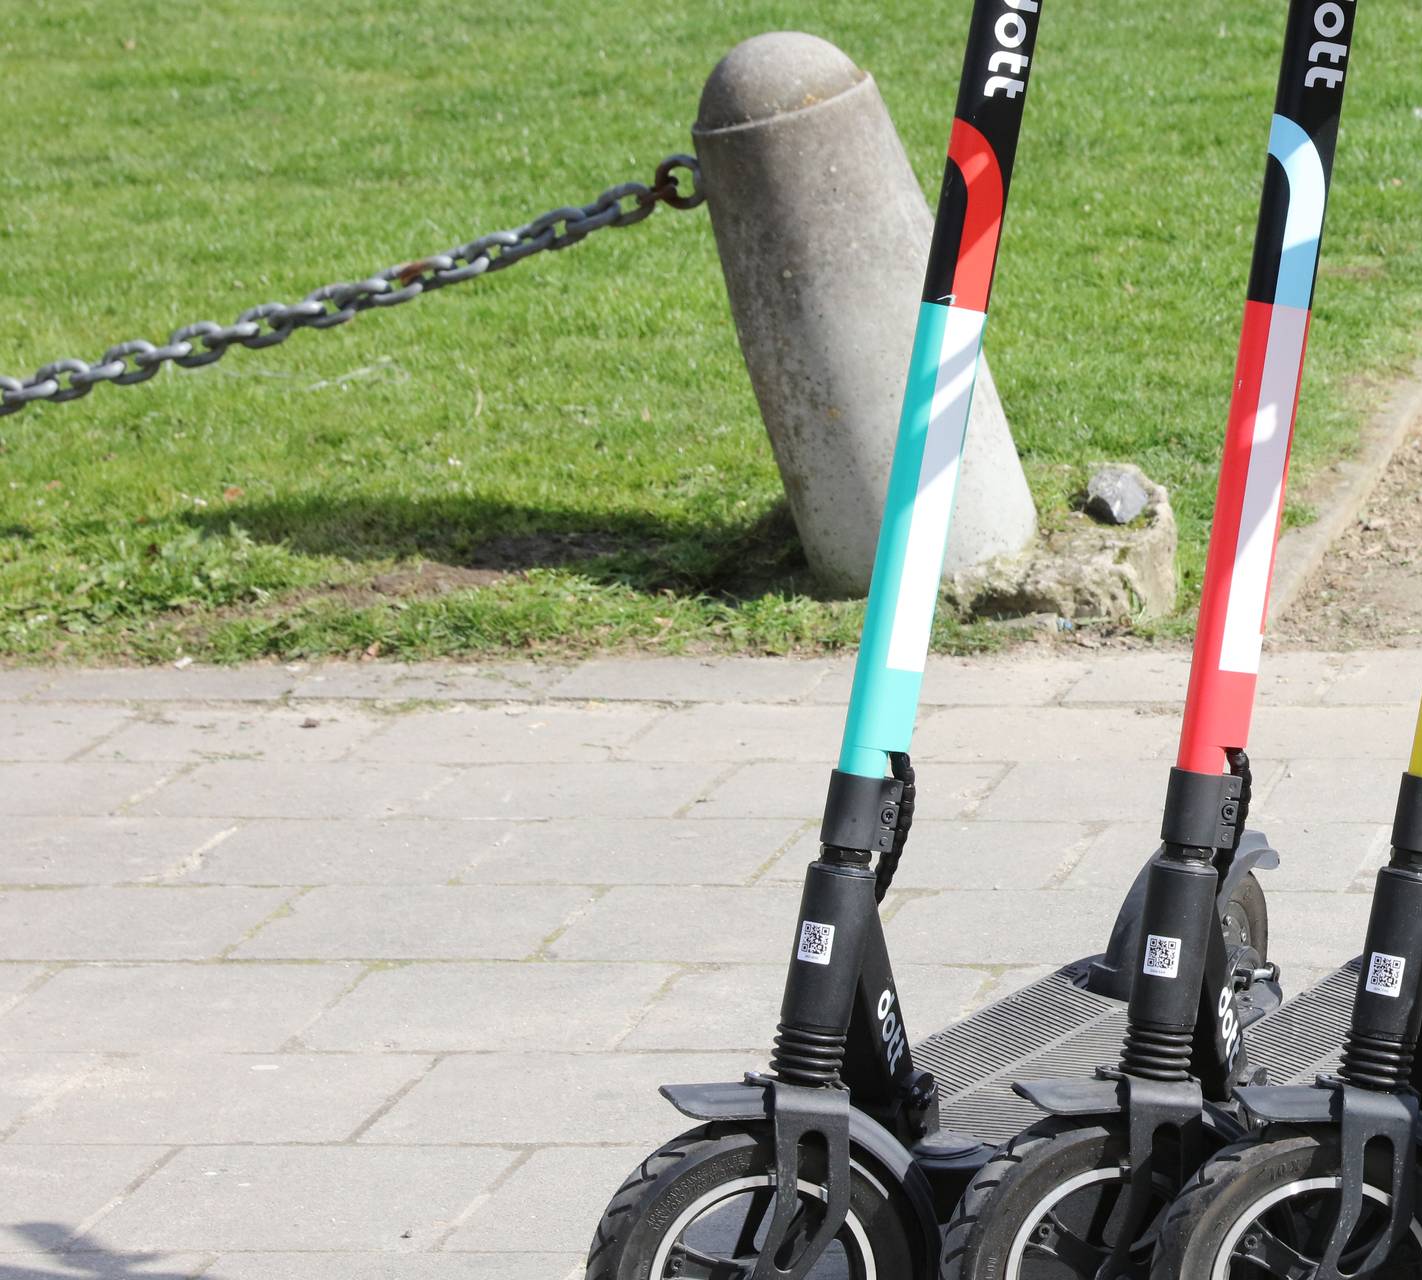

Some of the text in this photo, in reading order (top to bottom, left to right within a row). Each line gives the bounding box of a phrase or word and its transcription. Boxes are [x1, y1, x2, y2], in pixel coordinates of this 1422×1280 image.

[1304, 0, 1354, 89] ott
[877, 989, 904, 1076] dott
[1218, 986, 1241, 1073] dott
